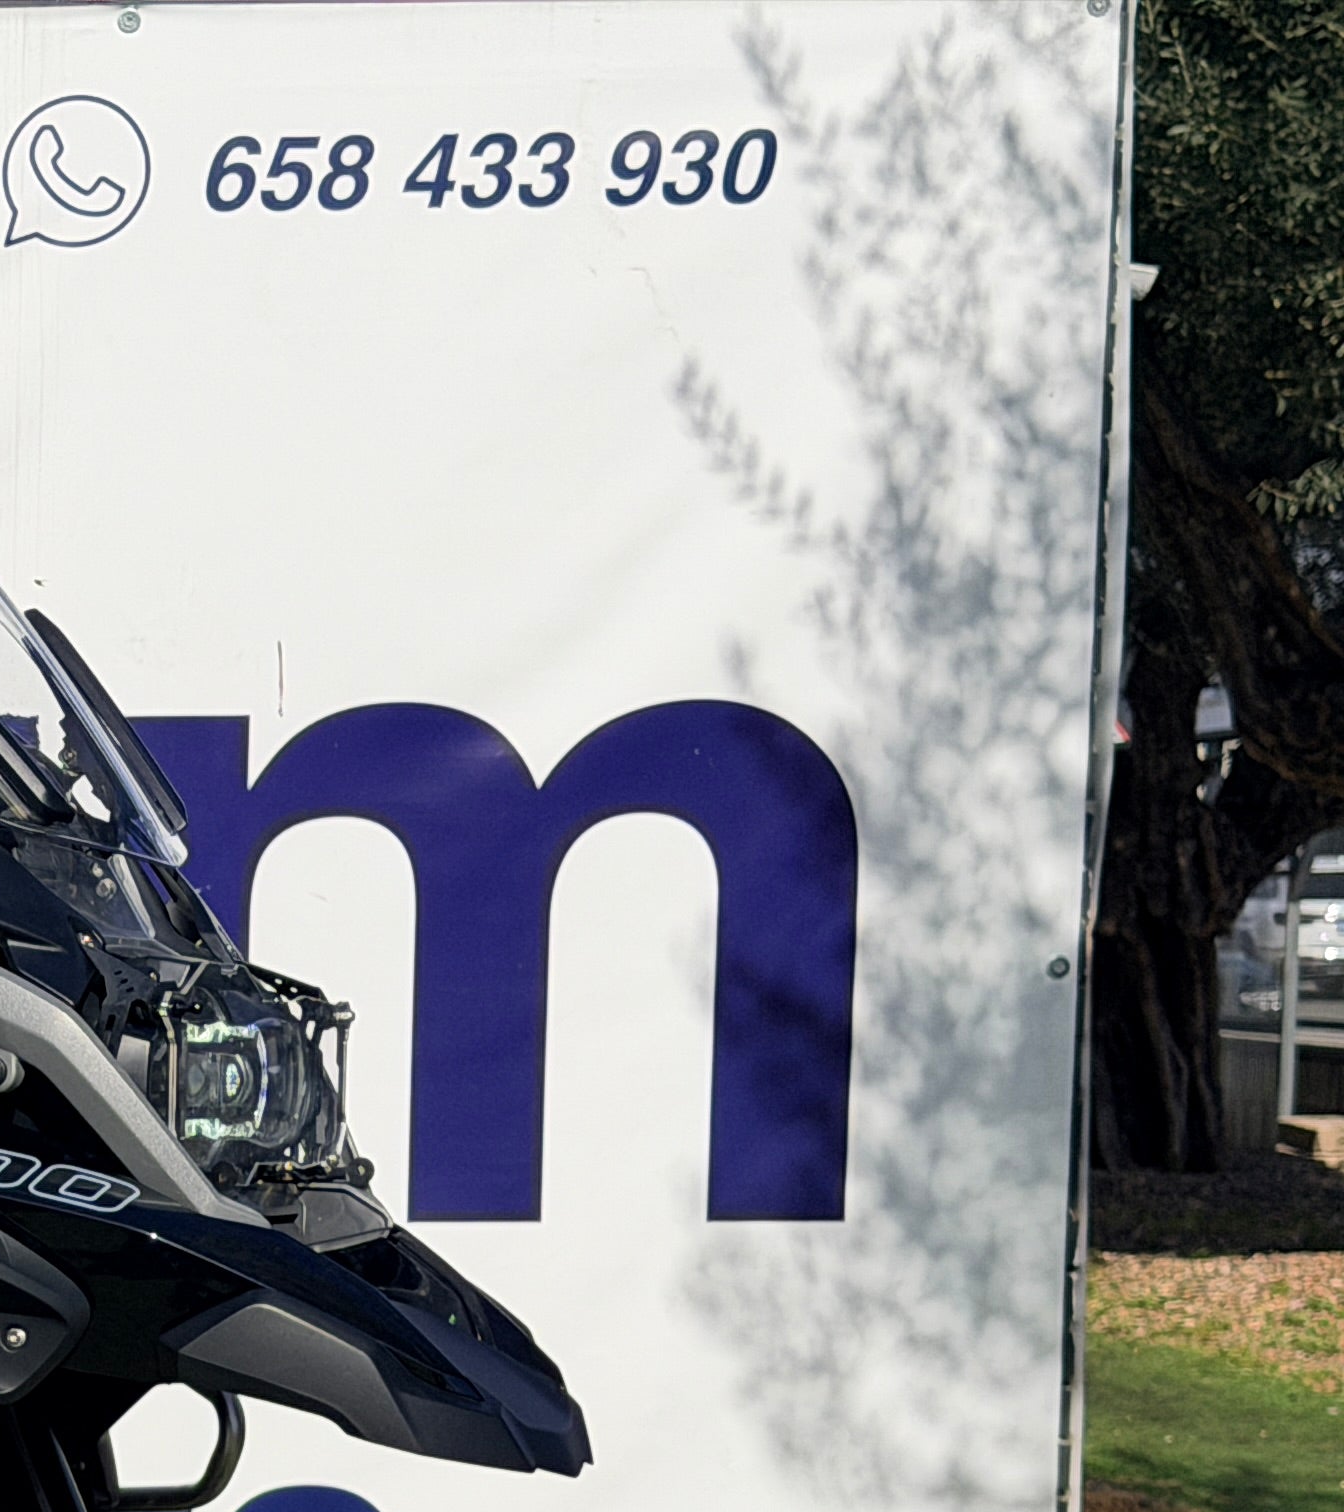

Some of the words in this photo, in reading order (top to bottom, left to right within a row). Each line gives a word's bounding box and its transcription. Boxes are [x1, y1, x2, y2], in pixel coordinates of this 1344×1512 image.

[206, 134, 375, 212] 658
[403, 131, 575, 209] 433
[605, 128, 779, 207] 930
